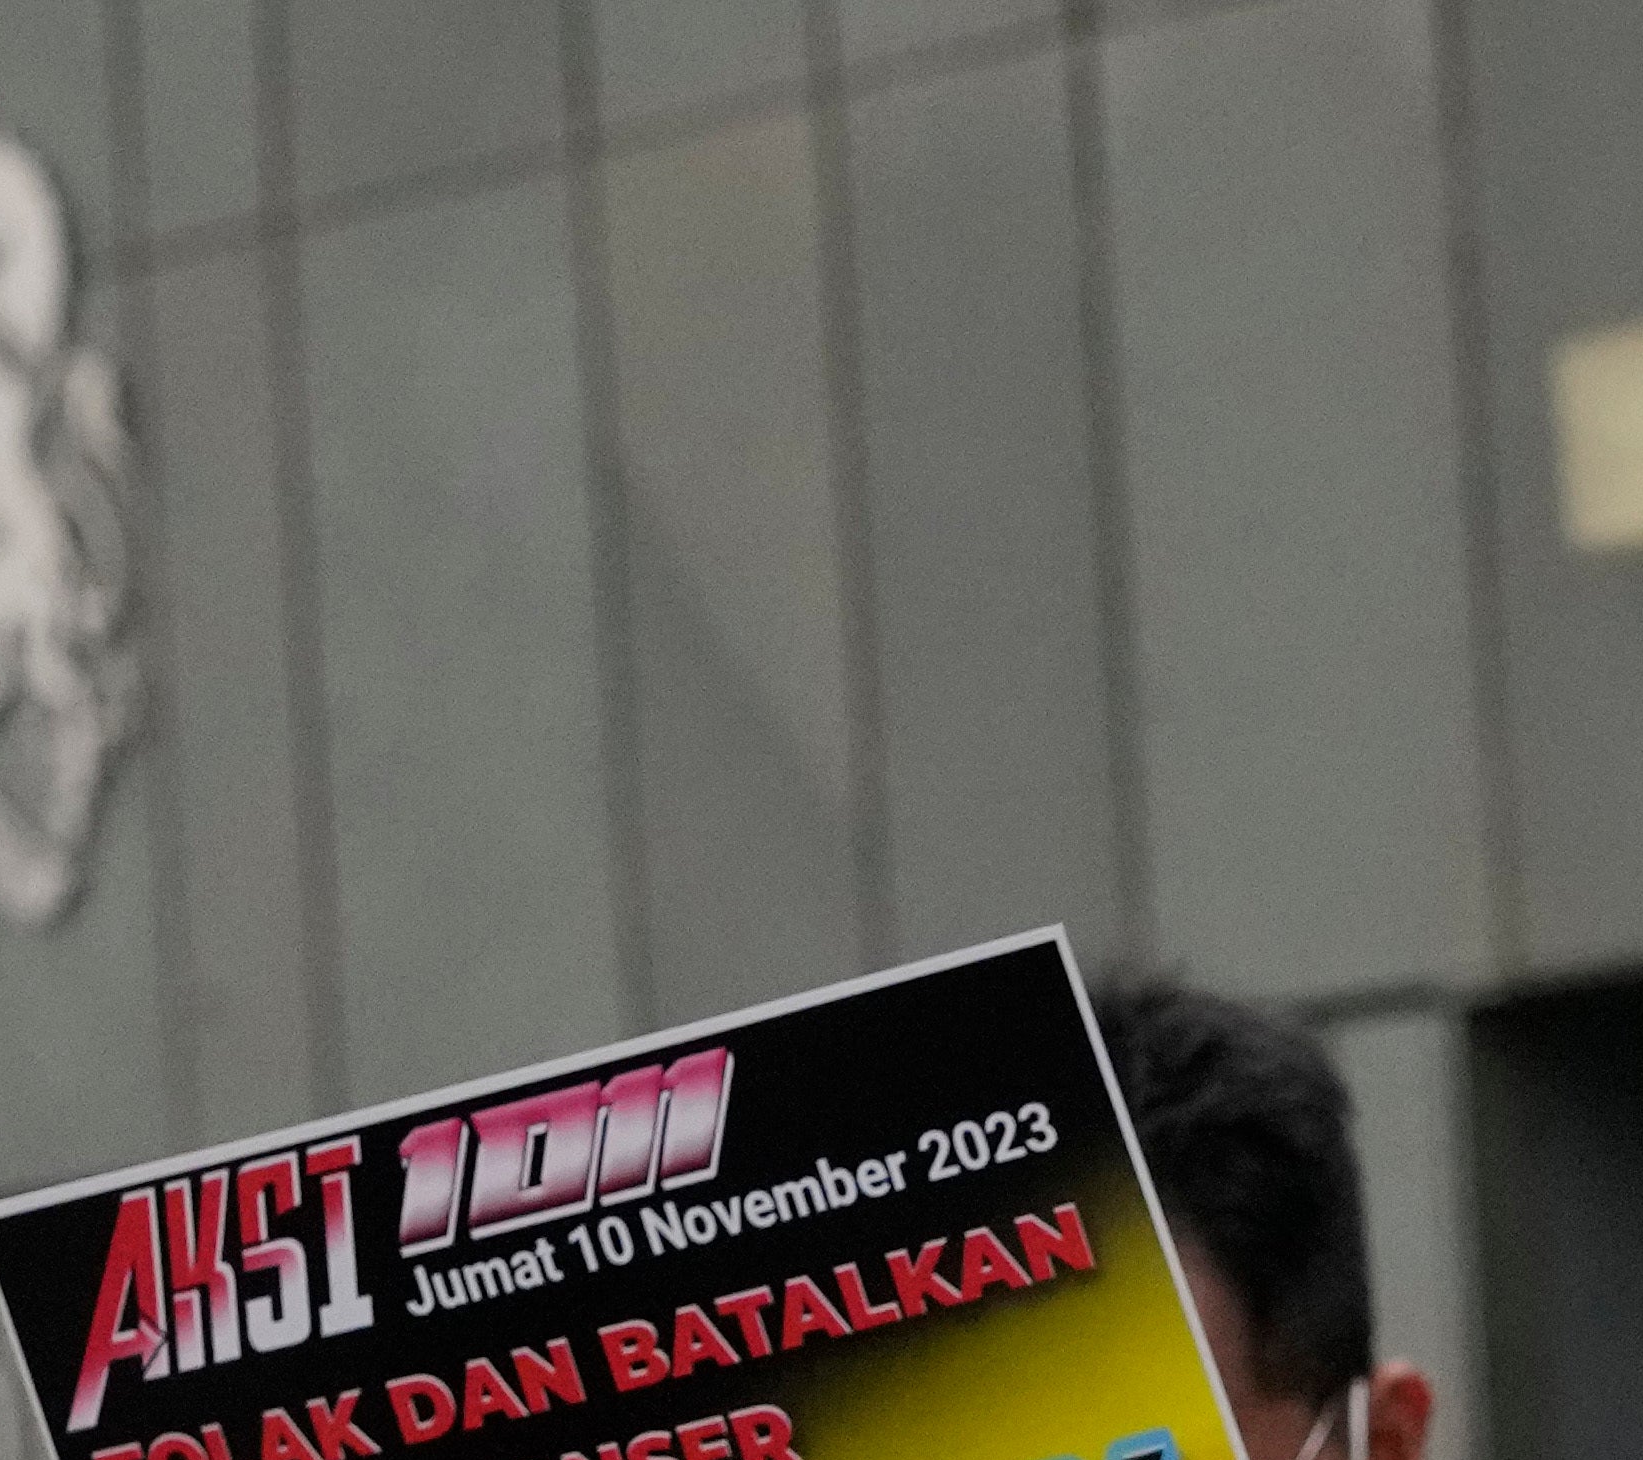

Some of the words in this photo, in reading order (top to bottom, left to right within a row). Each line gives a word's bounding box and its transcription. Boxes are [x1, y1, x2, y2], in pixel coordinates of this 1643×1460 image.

[67, 1137, 374, 1433] AKSI
[386, 1337, 587, 1447] DAN
[598, 1203, 1096, 1394] BATALKAN
[407, 1232, 564, 1316] Jumat
[569, 1207, 631, 1273] 10
[639, 1146, 907, 1258] November
[917, 1101, 1058, 1184] 2023
